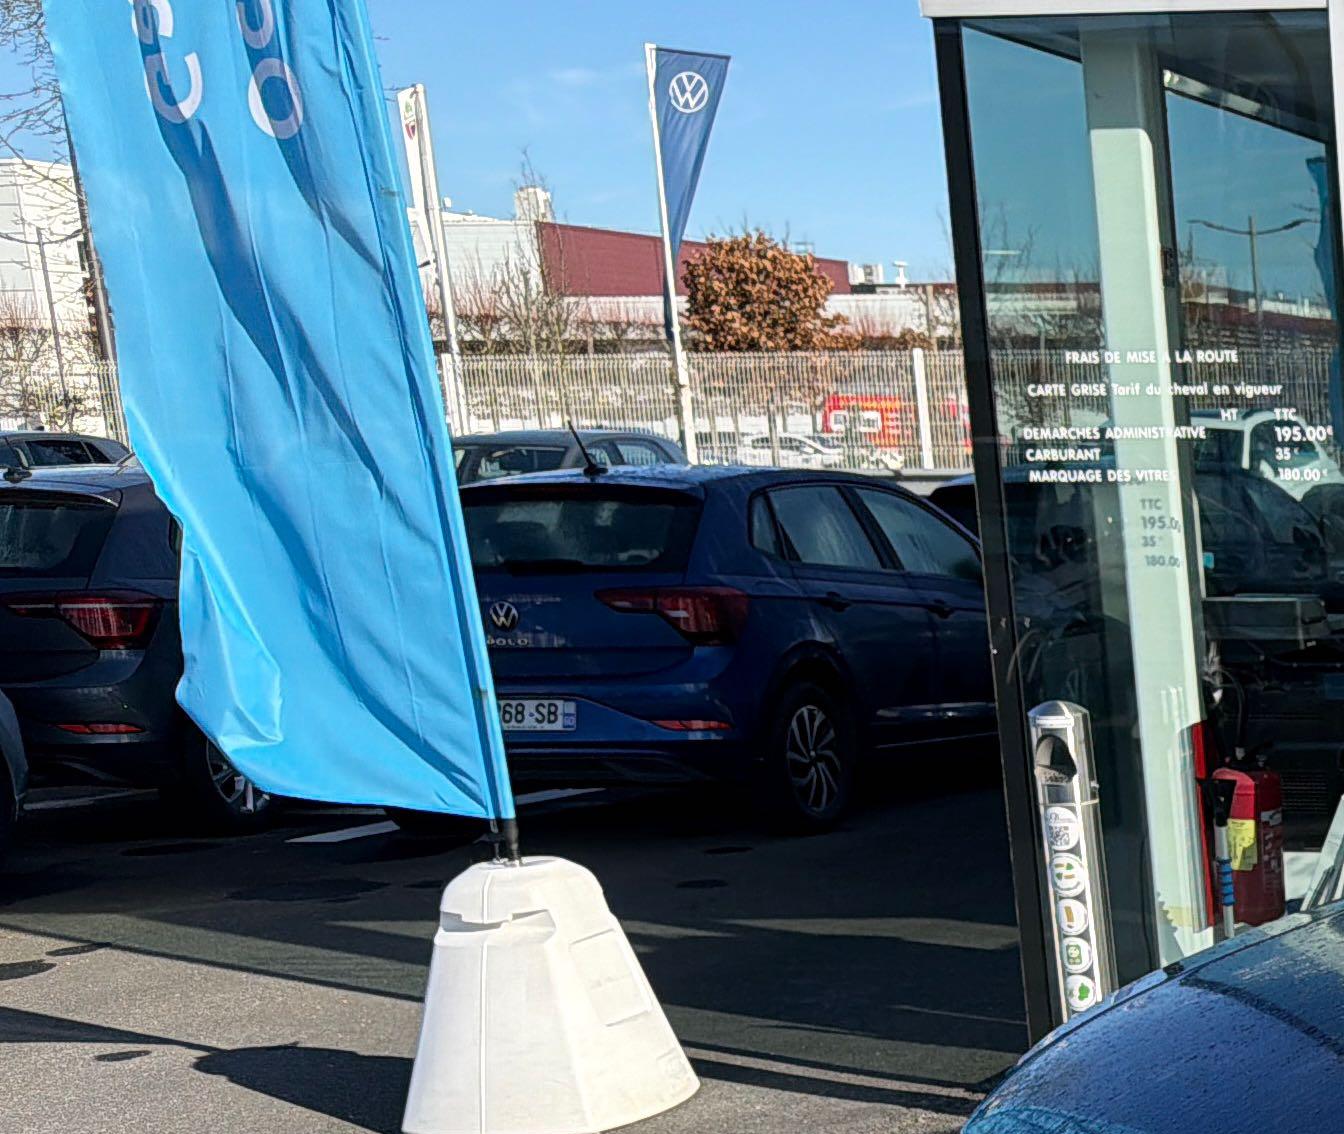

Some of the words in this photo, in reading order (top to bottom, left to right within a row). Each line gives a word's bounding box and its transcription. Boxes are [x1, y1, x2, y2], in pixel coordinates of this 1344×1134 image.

[1065, 351, 1100, 365] FRAIS
[1104, 351, 1121, 364] DE
[1126, 350, 1157, 364] MISE
[1175, 350, 1193, 363] LA
[1198, 349, 1239, 364] ROUTE
[1027, 383, 1066, 397] CARTE
[1071, 383, 1108, 397] GRISE
[1112, 382, 1141, 396] Tarif
[1146, 382, 1162, 396] du
[1168, 381, 1208, 396] cheval
[1213, 384, 1230, 396] en
[1234, 381, 1283, 399] vigueur
[1220, 408, 1239, 422] HT
[1273, 408, 1297, 422] TTC
[1023, 426, 1100, 440] DEMARCHES
[1025, 449, 1101, 462] CARBURANT
[1029, 469, 1102, 483] MARQUAGE
[1107, 469, 1132, 483] DES
